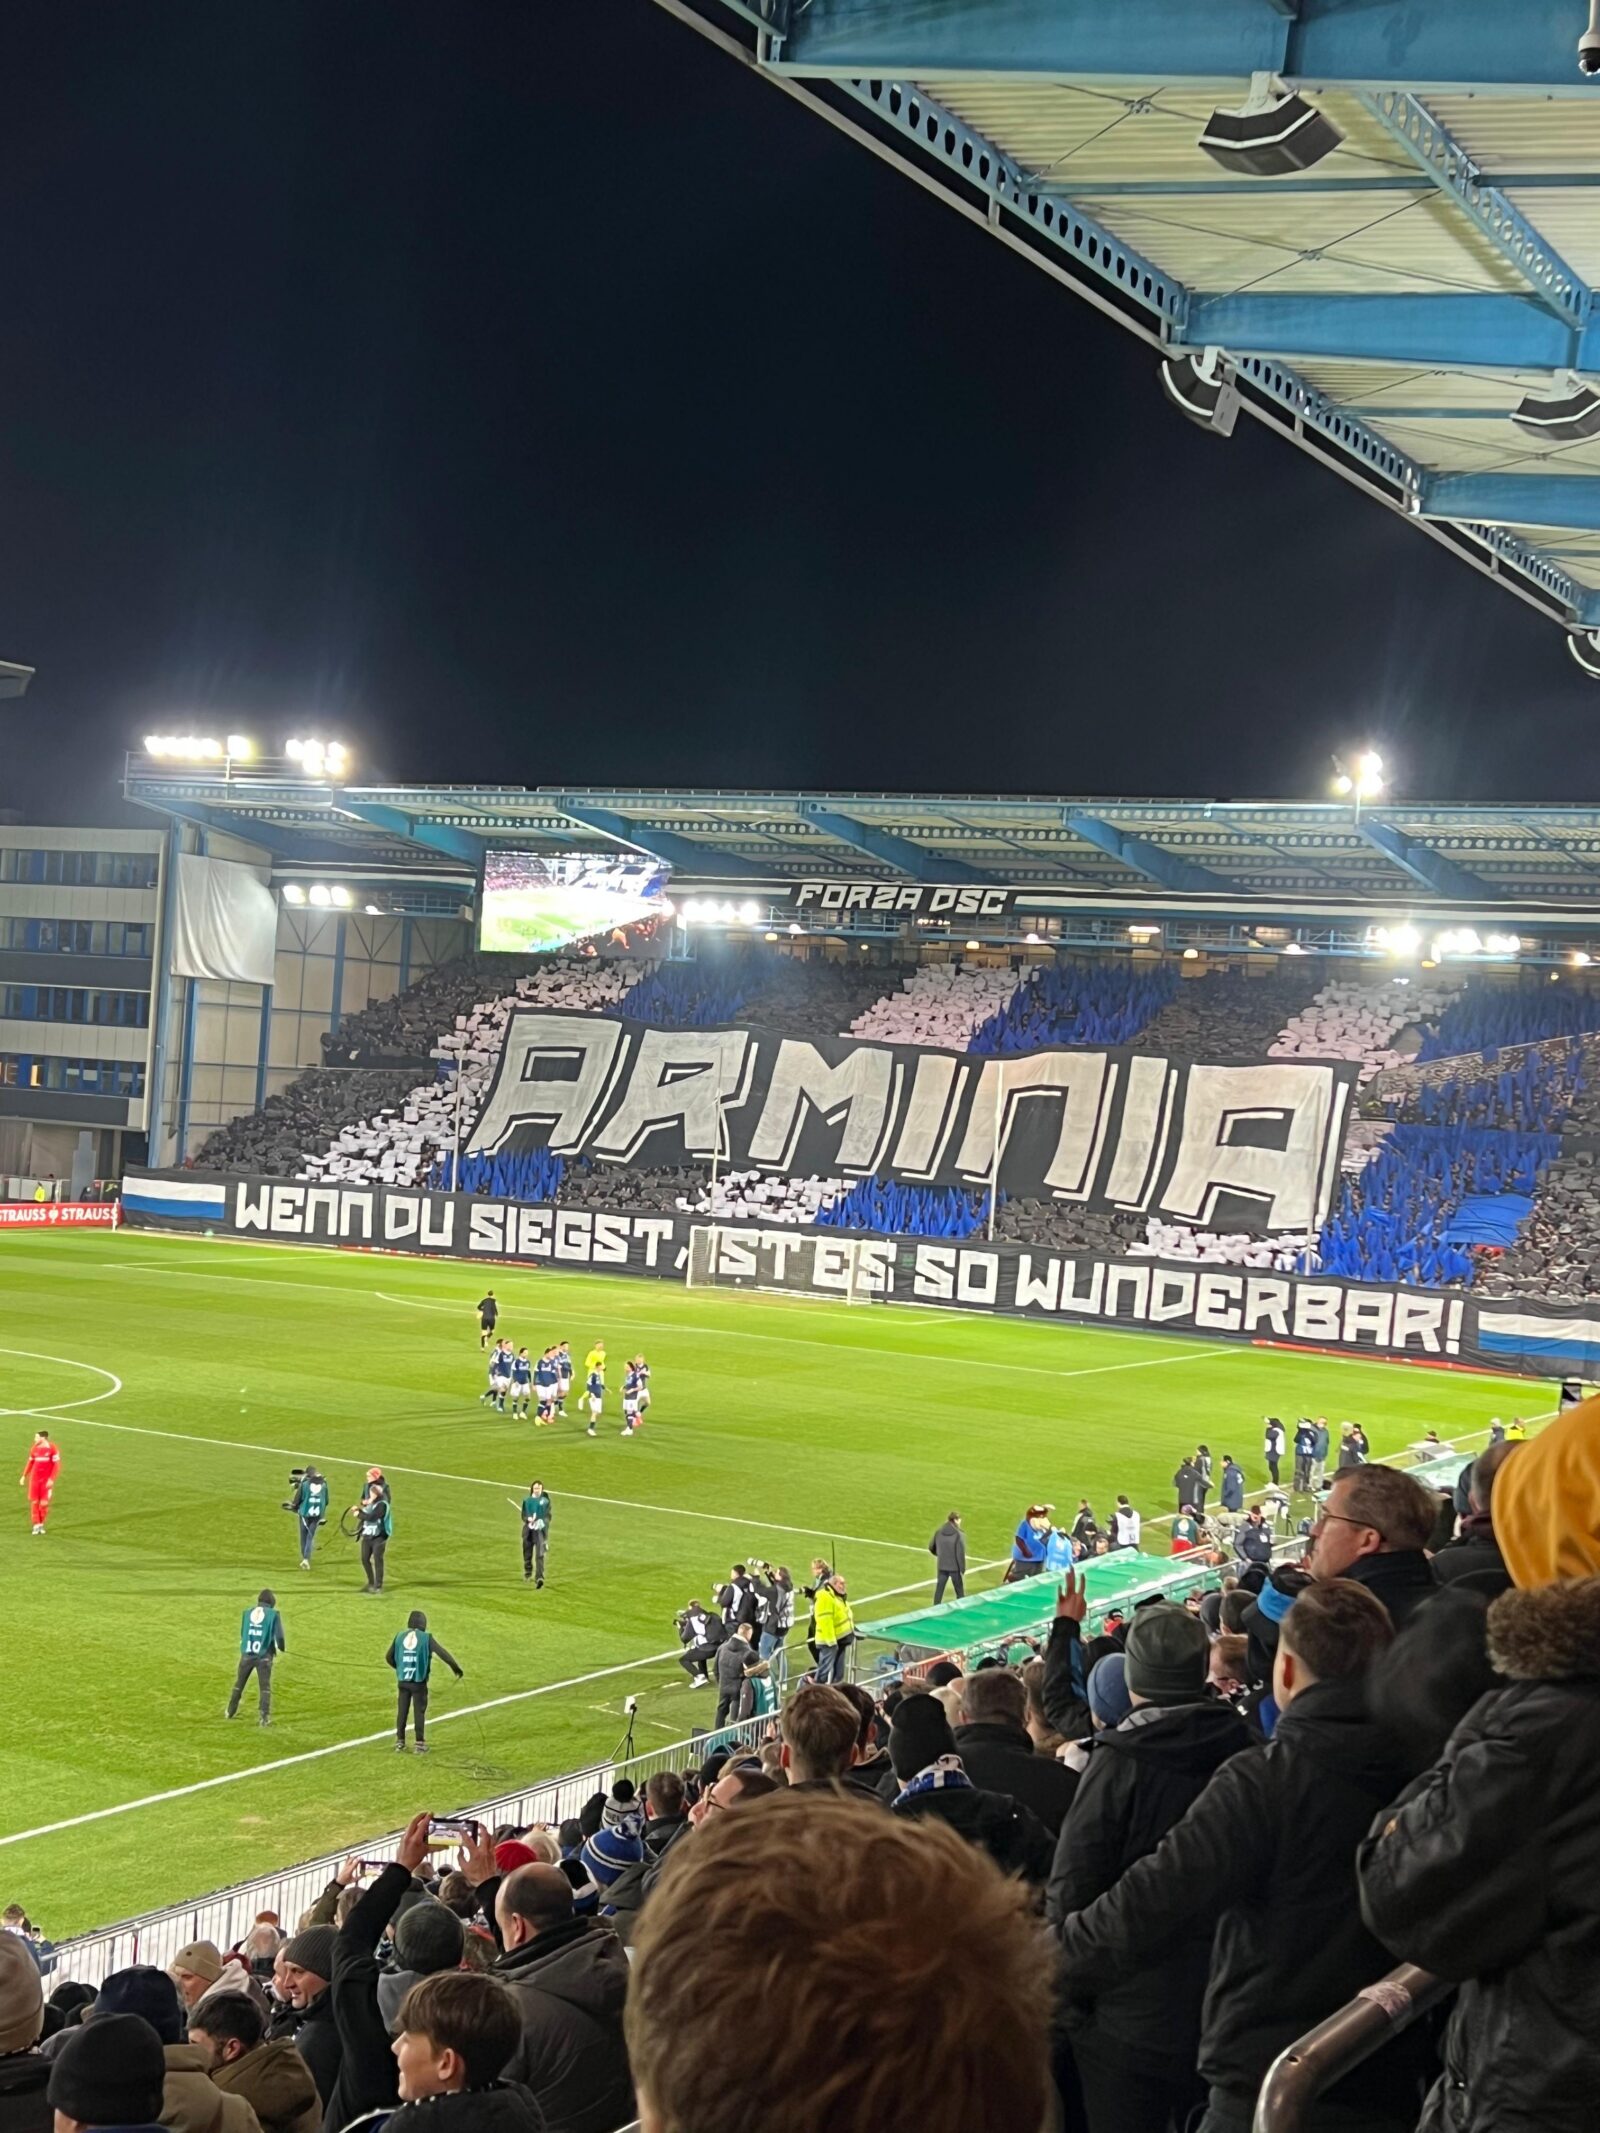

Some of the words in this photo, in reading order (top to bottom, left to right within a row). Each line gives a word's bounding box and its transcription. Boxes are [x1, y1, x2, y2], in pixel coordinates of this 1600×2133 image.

[796, 884, 923, 911] FORZA
[929, 888, 1008, 914] DSC
[467, 1015, 1348, 1230] ARMINIA
[0, 1208, 46, 1222] TRAUSS
[61, 1207, 118, 1221] STRAUSS
[235, 1182, 373, 1238] WENN
[385, 1194, 455, 1247] DU
[469, 1203, 688, 1269] SIEGST,
[708, 1226, 801, 1280] IST
[813, 1235, 898, 1292] ES
[914, 1244, 998, 1304] SO
[1015, 1254, 1464, 1355] WUNDERBAR!
[246, 1640, 261, 1653] 10
